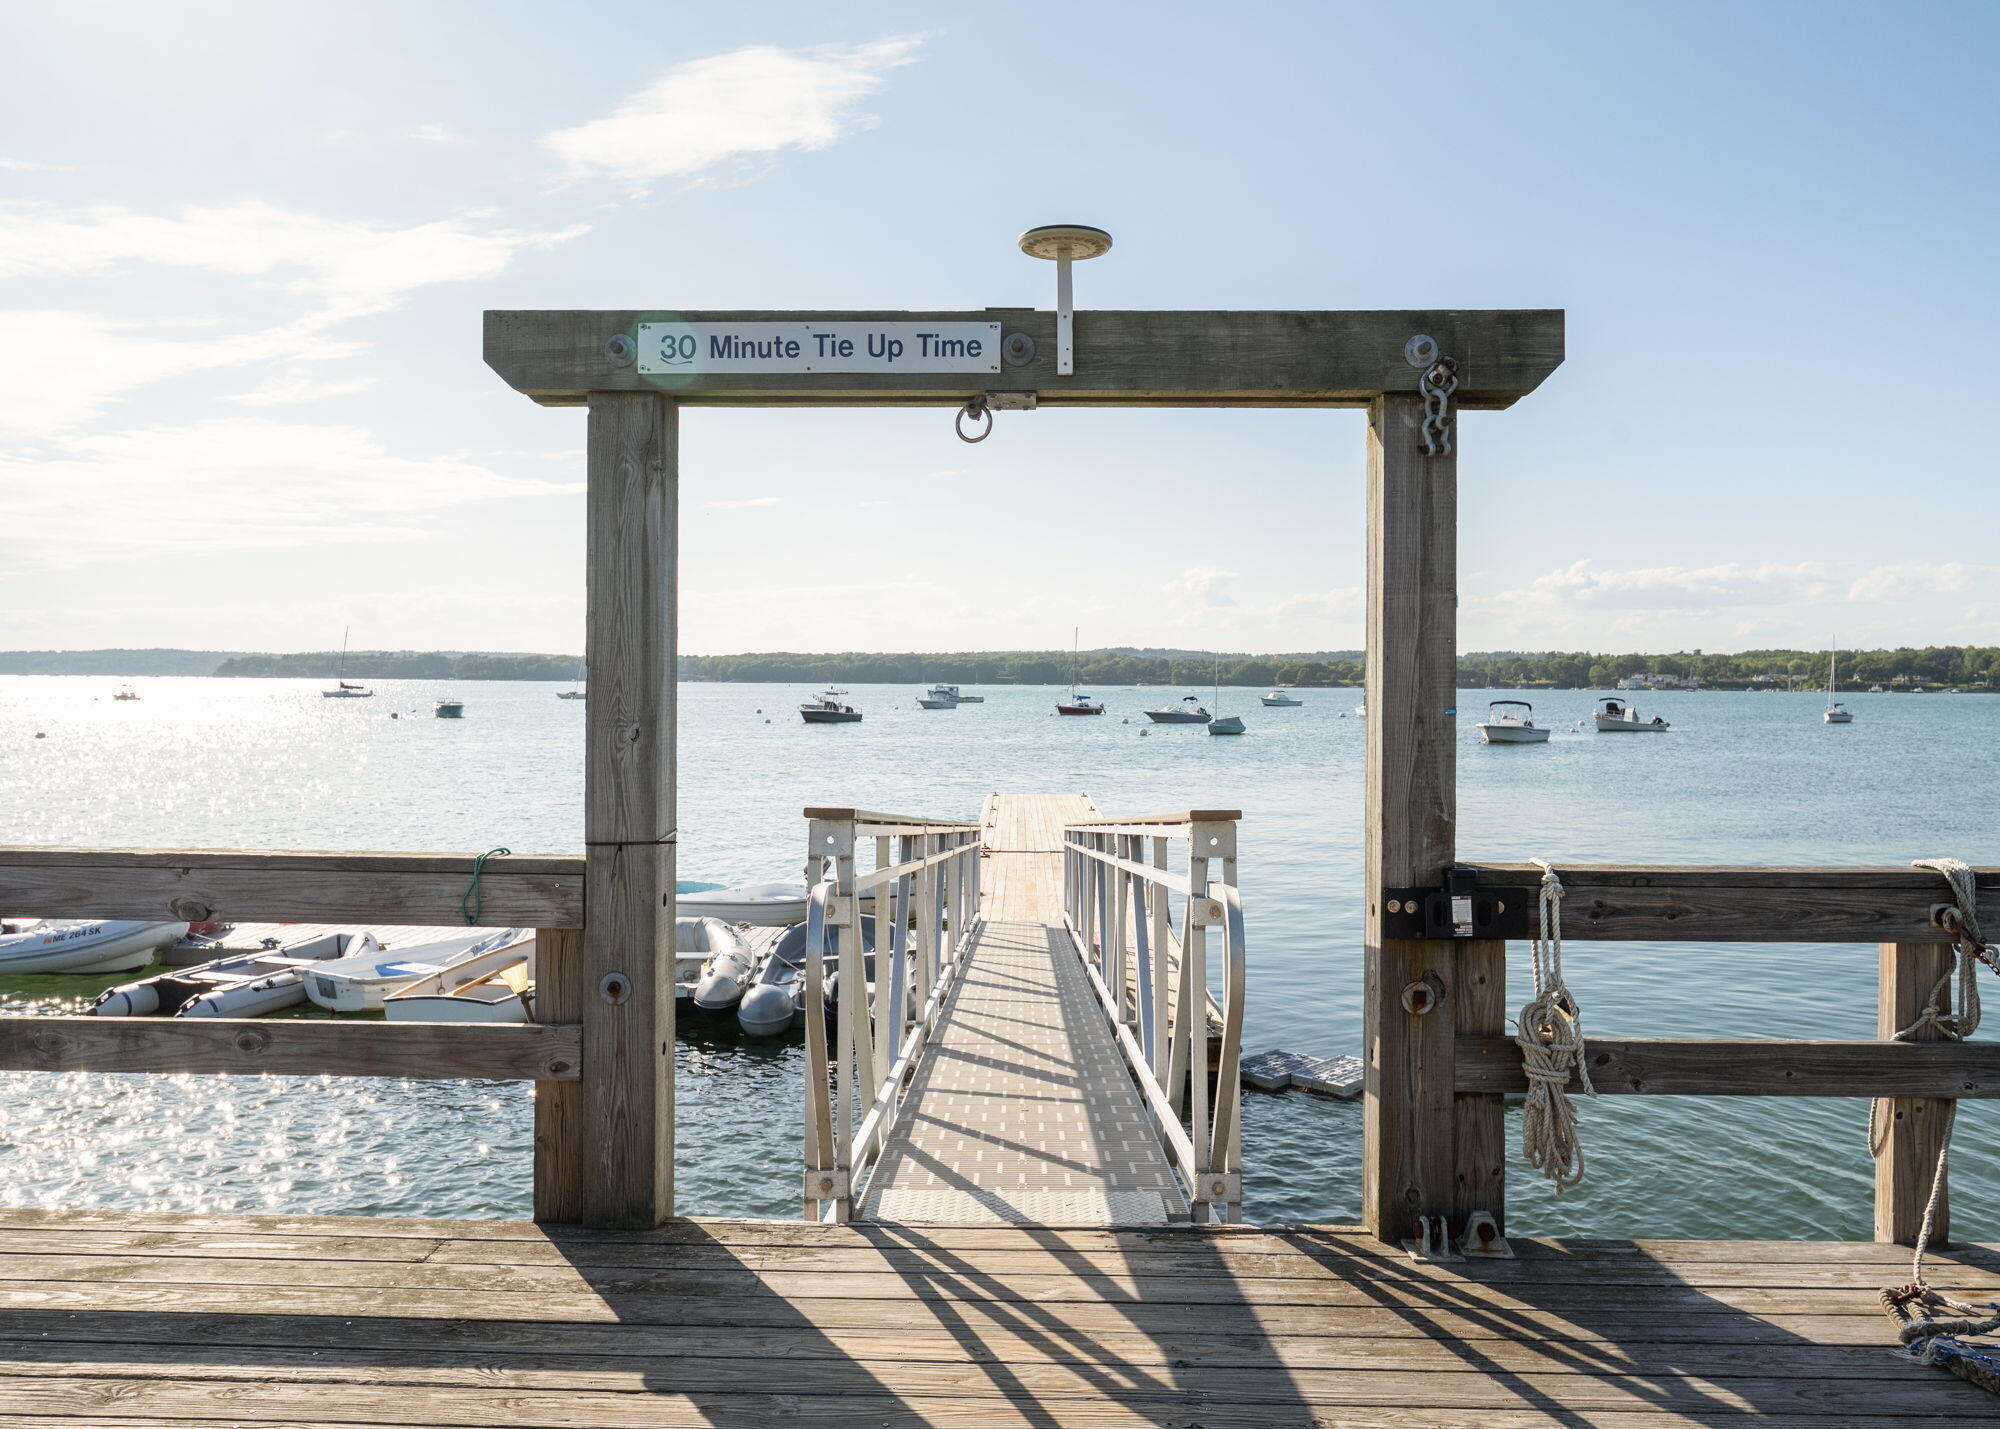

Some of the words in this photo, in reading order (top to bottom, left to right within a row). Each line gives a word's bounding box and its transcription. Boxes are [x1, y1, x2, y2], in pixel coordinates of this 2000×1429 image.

[660, 334, 697, 360] 30
[709, 334, 801, 359] Minute
[812, 333, 855, 358] Tie
[867, 333, 904, 363] Up
[915, 332, 983, 358] Time
[52, 933, 67, 943] ME
[69, 929, 87, 940] 264
[88, 926, 102, 936] SK
